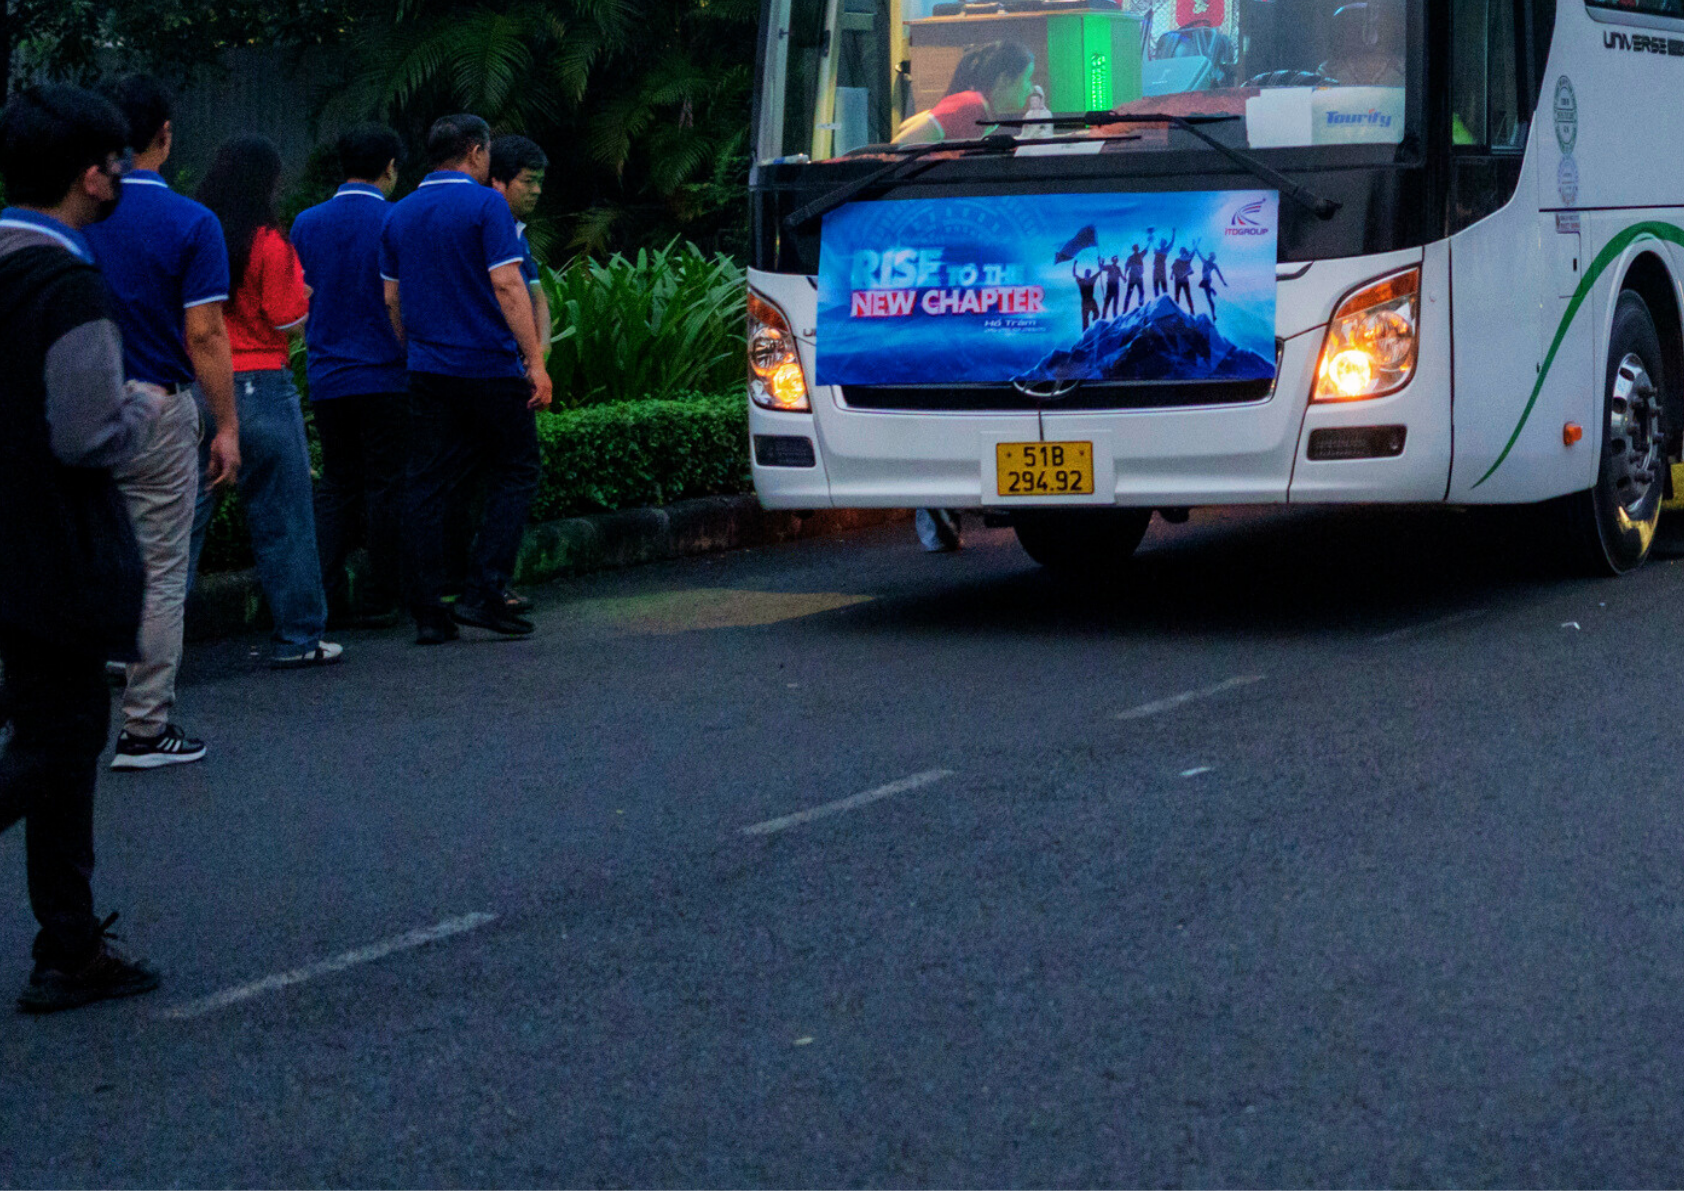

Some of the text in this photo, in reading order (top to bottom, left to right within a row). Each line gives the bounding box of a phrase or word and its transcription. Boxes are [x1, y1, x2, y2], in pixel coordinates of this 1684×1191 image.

[1326, 108, 1392, 127] Tourify
[851, 246, 945, 289] RISE
[946, 263, 979, 286] TO
[850, 286, 1047, 318] NEW CHAPTER
[1023, 445, 1064, 467] 51B
[1008, 470, 1083, 492] 294.92
